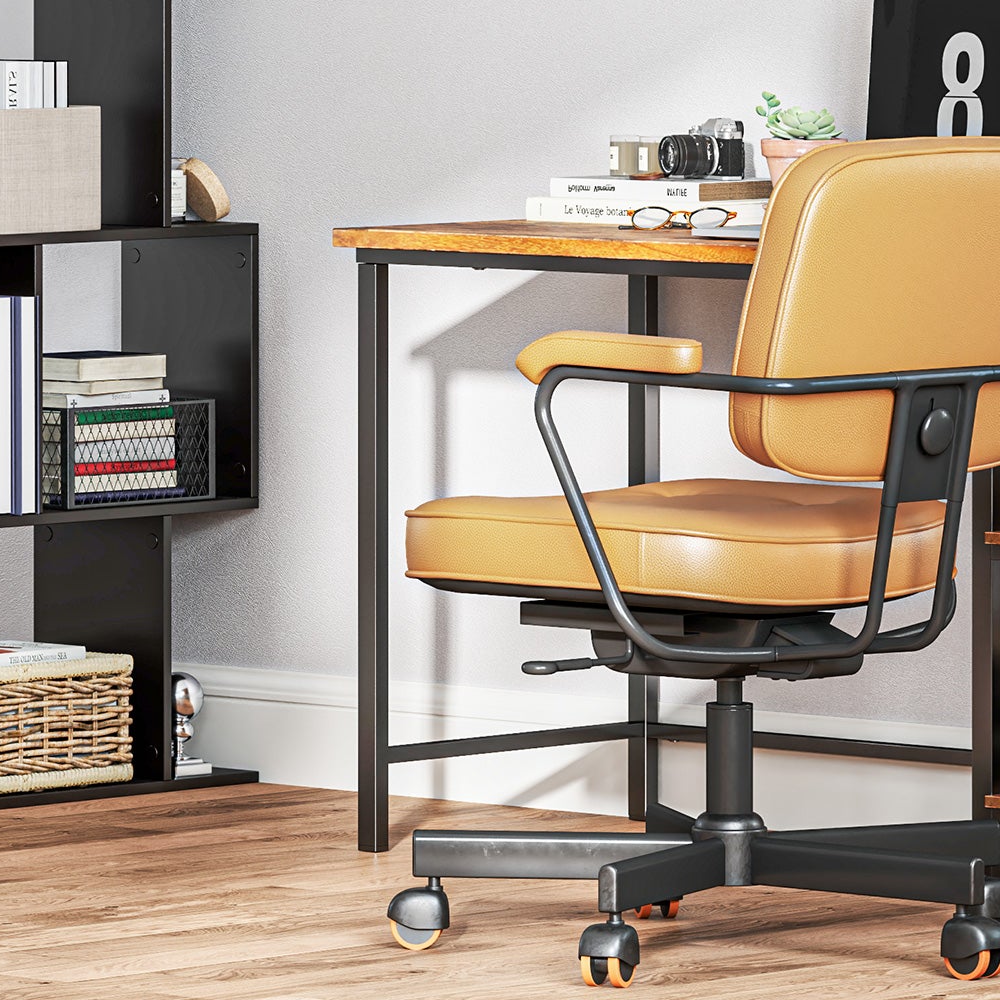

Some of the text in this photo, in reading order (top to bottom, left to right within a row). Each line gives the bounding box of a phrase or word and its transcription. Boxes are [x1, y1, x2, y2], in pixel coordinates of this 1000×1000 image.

[564, 204, 631, 218] Le Voyage botan
